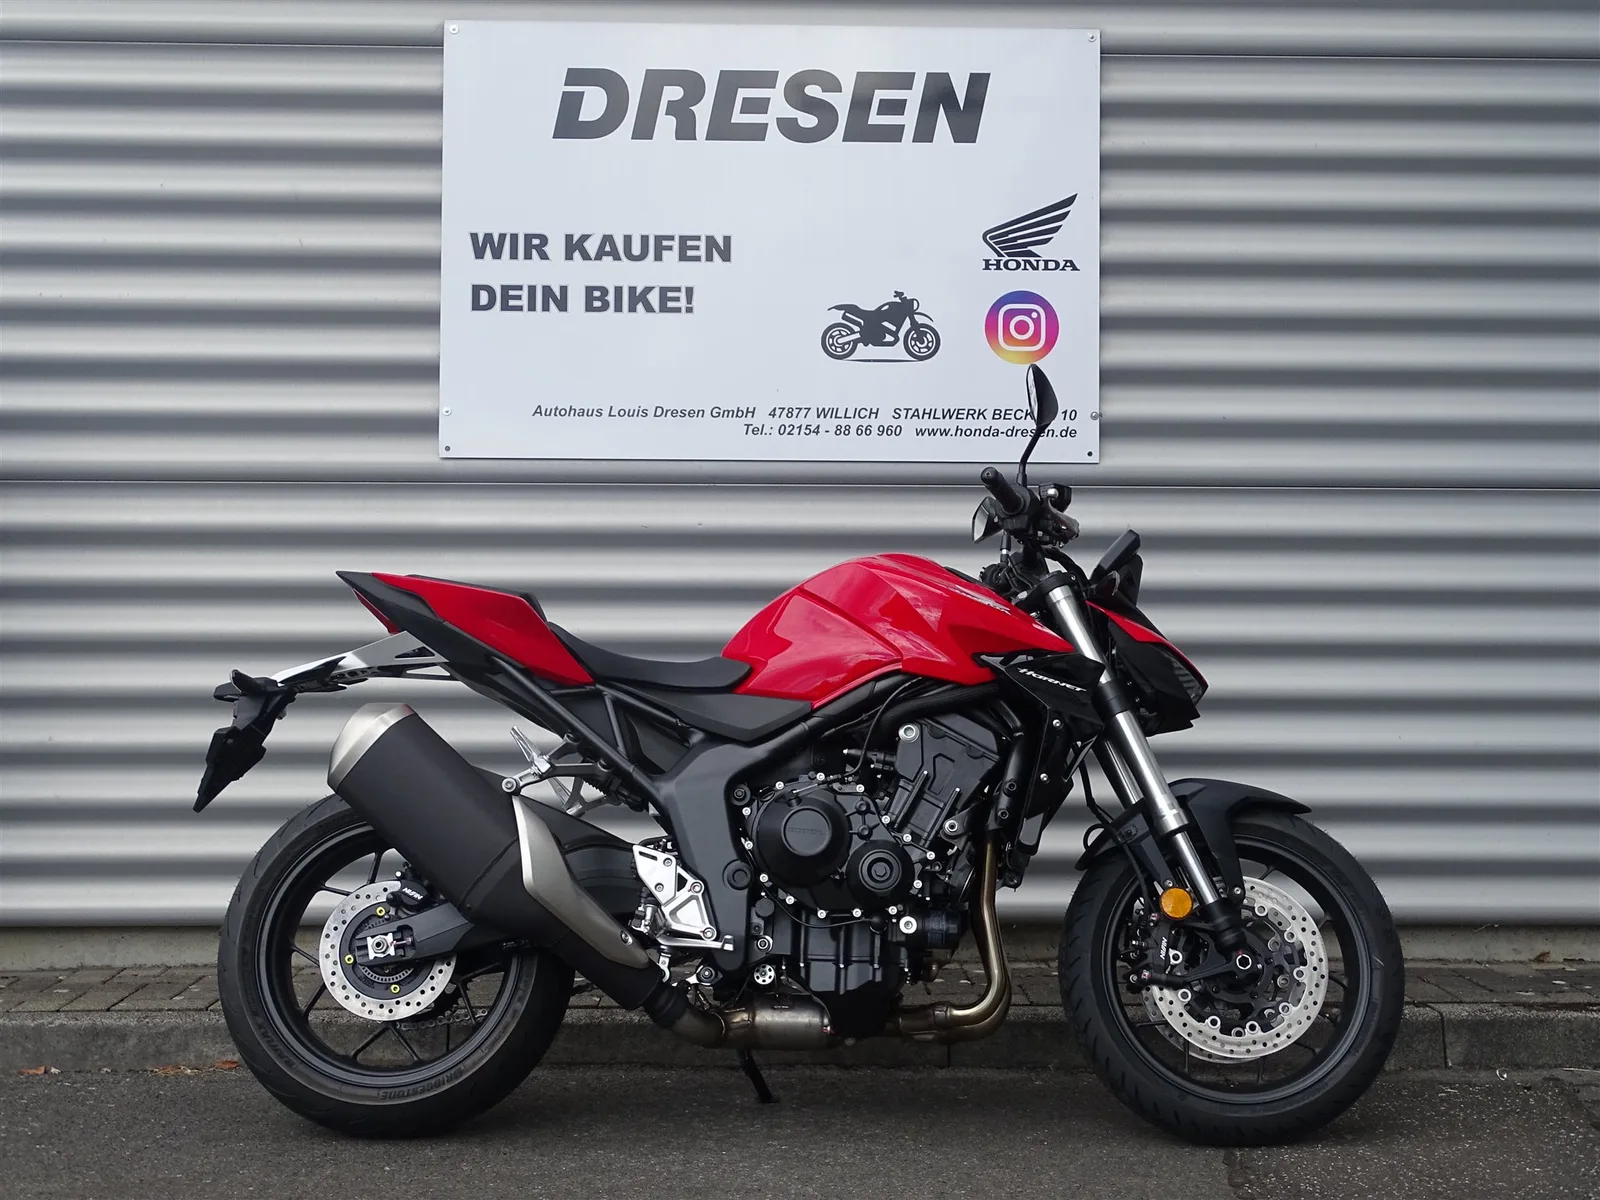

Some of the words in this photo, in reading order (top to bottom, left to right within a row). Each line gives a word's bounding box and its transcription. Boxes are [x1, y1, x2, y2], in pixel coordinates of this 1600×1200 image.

[552, 67, 991, 144] DRESEN
[470, 232, 551, 261] WIR
[564, 233, 733, 263] KAUFEN
[982, 258, 1081, 272] HONDA
[471, 284, 568, 313] DEIN
[584, 285, 695, 314] BIKE!
[532, 404, 604, 418] Autohaus
[607, 405, 649, 418] Louis
[653, 406, 705, 419] Dresen
[709, 406, 757, 419] GmbH
[768, 406, 812, 419] 47877
[816, 407, 880, 420] WILLICH
[891, 408, 988, 421] STAHLWERK
[991, 408, 1045, 421] BECK
[1061, 408, 1078, 421] 10
[743, 423, 774, 436] Tel.:
[777, 423, 821, 437] 02154
[833, 424, 852, 437] 88
[855, 424, 873, 437] 66
[876, 424, 903, 437] 960
